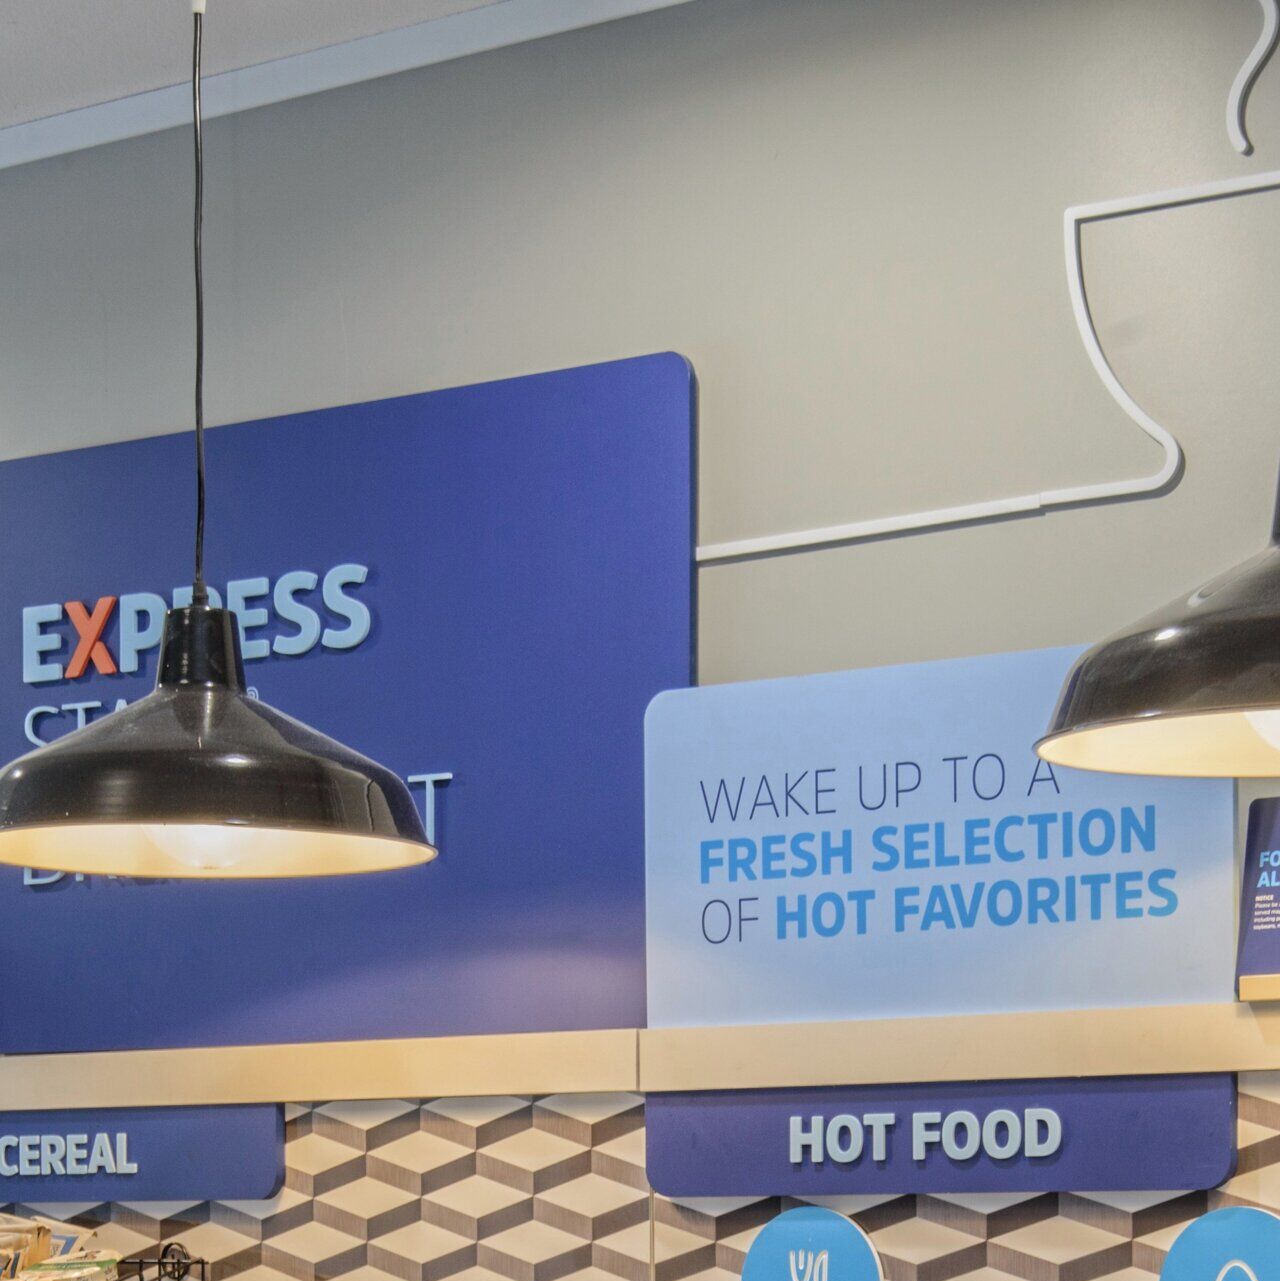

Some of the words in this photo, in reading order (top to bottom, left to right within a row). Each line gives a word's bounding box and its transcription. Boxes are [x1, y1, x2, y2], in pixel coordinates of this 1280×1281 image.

[22, 563, 372, 684] EXPESS
[698, 768, 838, 825] WAKE
[858, 761, 922, 811] UP
[942, 753, 1007, 802] TO
[1026, 758, 1061, 798] A
[699, 828, 853, 885] FRESH
[872, 804, 1157, 873] SELECTION
[701, 896, 760, 945] OF
[775, 889, 876, 940] HOT
[895, 868, 1178, 935] FAVORITES
[789, 1112, 896, 1164] HOT
[912, 1108, 1063, 1162] FOOD
